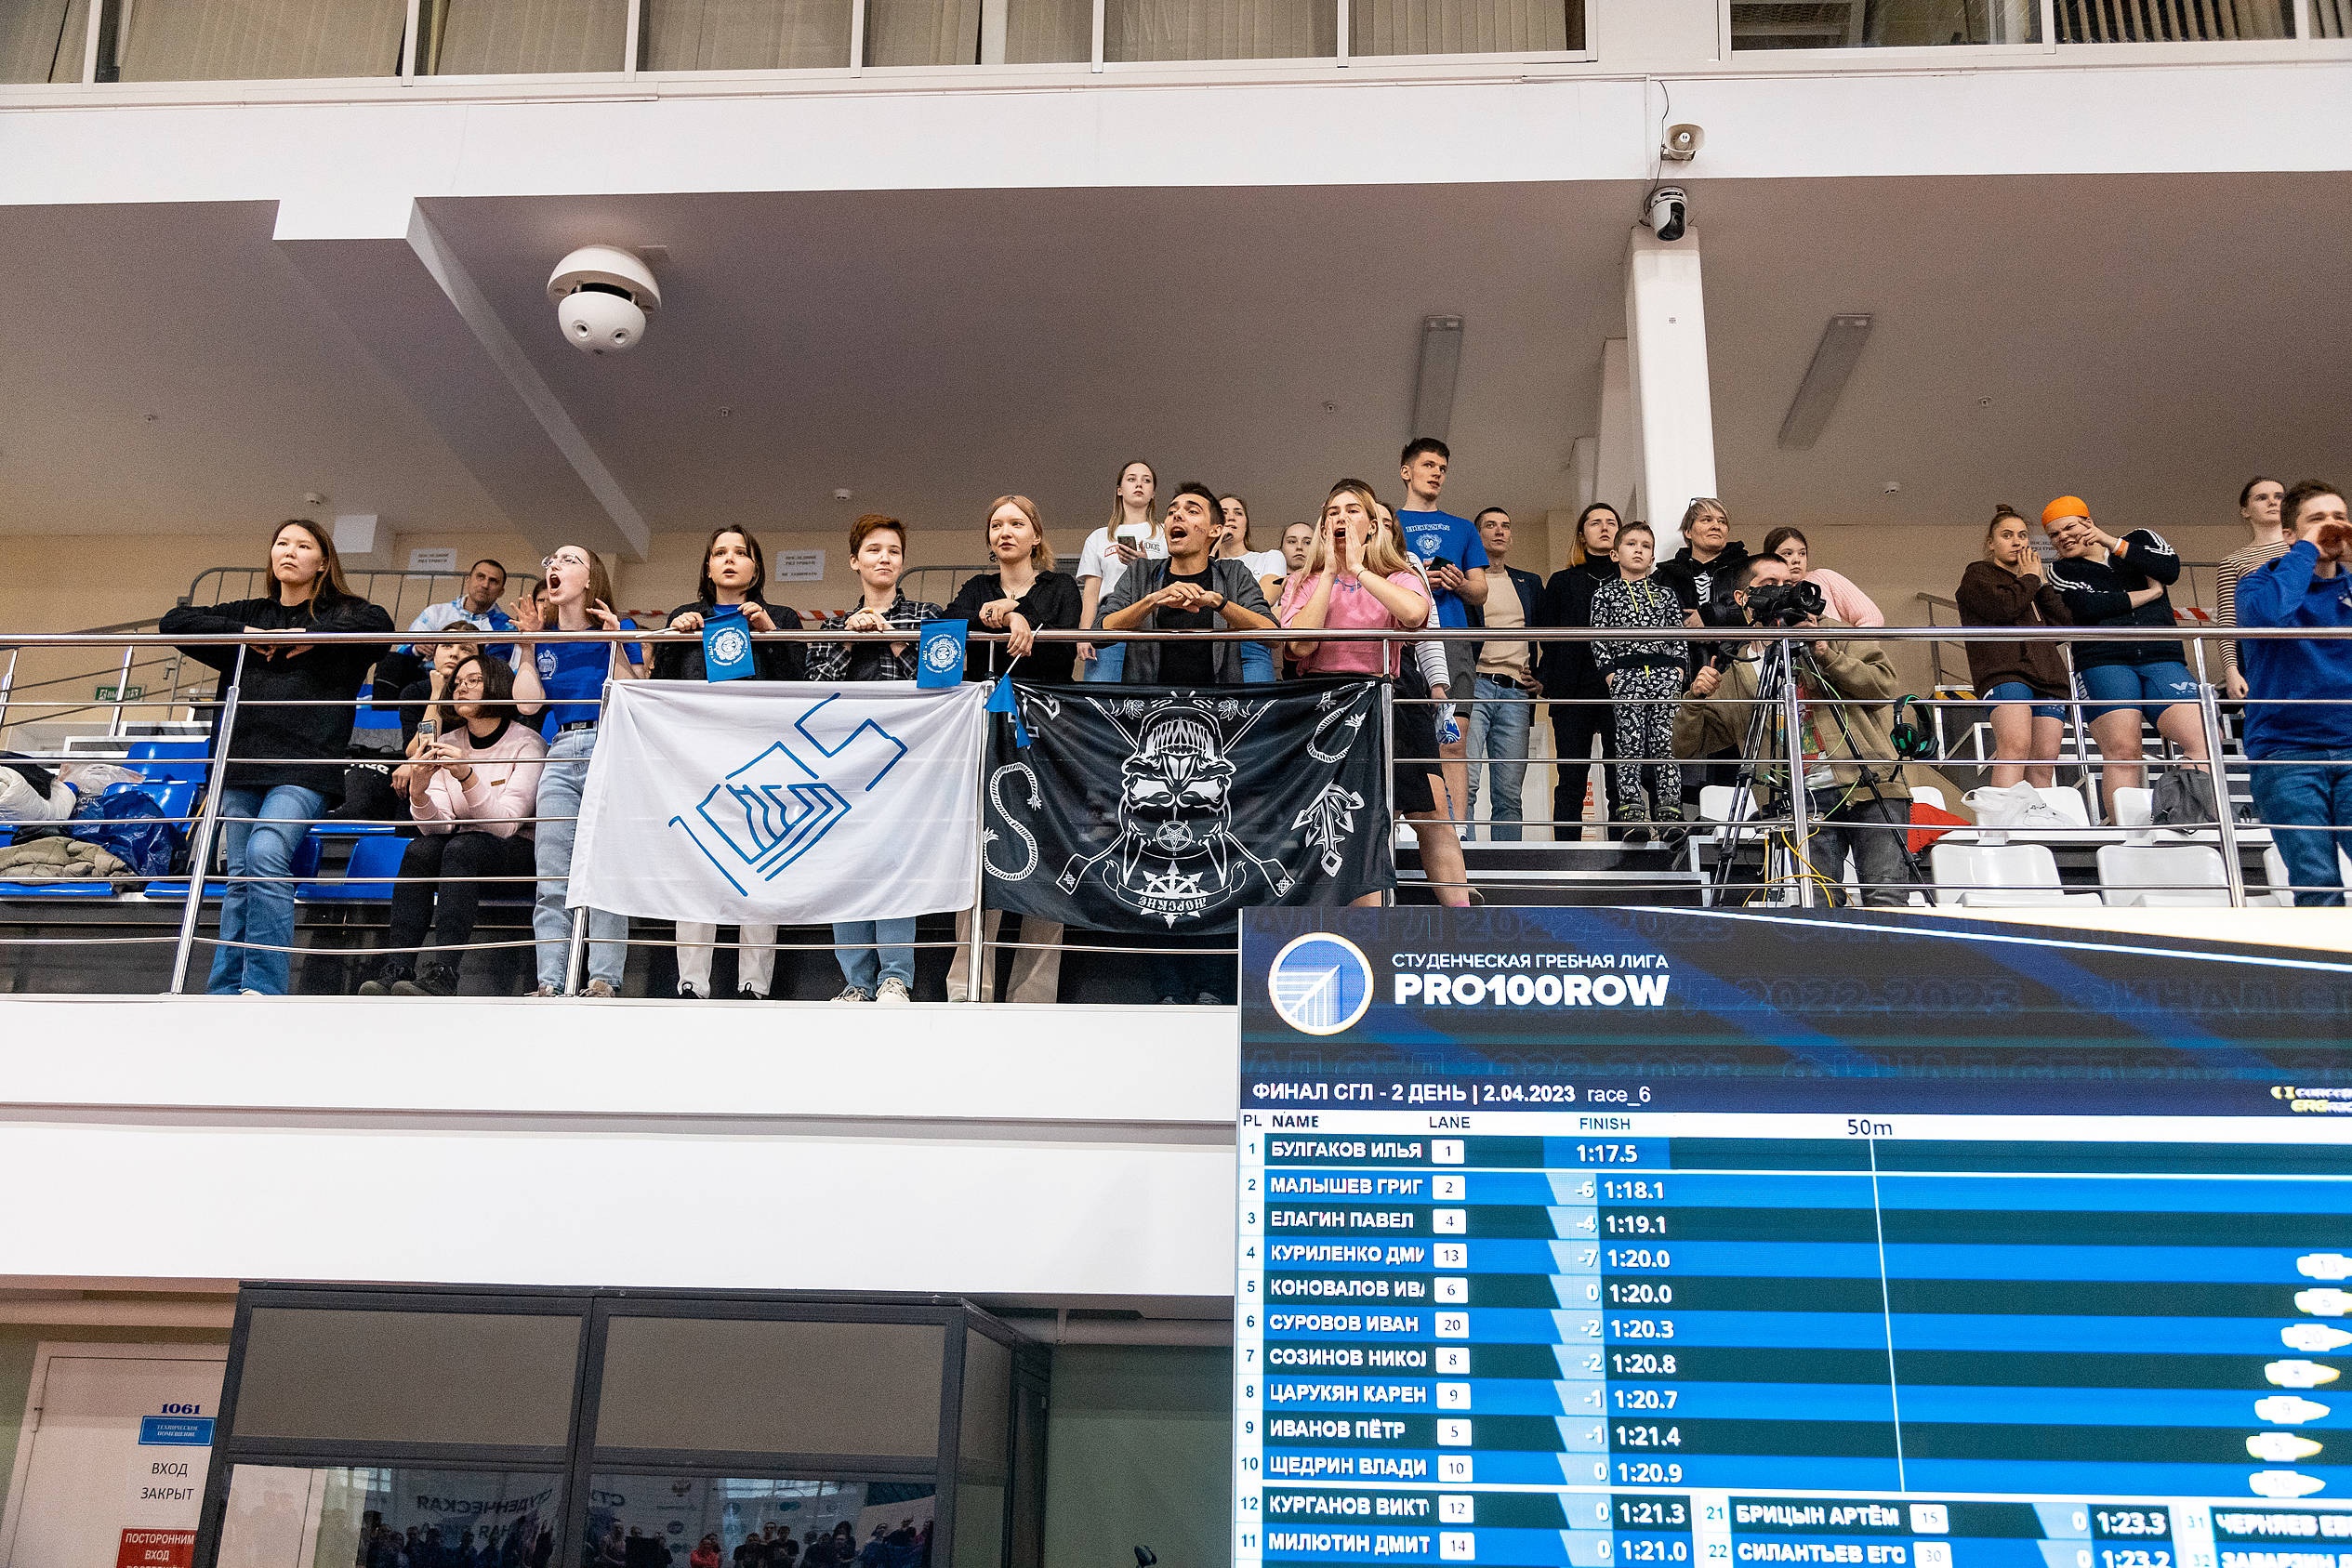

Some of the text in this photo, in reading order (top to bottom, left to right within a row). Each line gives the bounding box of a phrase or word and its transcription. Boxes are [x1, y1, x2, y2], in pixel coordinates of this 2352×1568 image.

[1137, 894, 1207, 912] МОРСКИЕ
[1391, 953, 1670, 970] СТУДЕНЧЕСКАЯ ГРЕБНАЯ ЛИГА
[1394, 973, 1671, 1007] PRO100ROW
[1252, 1082, 1328, 1100] ФИНАЛ
[1333, 1083, 1374, 1100] СГЛ
[1391, 1084, 1404, 1101] 2
[1407, 1084, 1467, 1104] ДЕНЬ
[1483, 1084, 1577, 1102] 2.04.2023
[1587, 1086, 1651, 1107] race_6
[1243, 1114, 1893, 1136] PL NAME LANE FINISH 50m
[1249, 1140, 1638, 1163] 1 БУЛГАКОВ ИЛЬЯ 1 1:17.5
[1248, 1178, 1256, 1191] 2
[1270, 1177, 1373, 1194] МАЛЫШЕВ
[1377, 1179, 1423, 1194] ГРИГ
[1445, 1181, 1453, 1193] 2
[1604, 1180, 1664, 1199] 1:18.1
[1248, 1211, 1256, 1225] 3
[1271, 1210, 1345, 1228] ЕЛАГИН
[1350, 1212, 1414, 1229] ПАВЕЛ
[1446, 1216, 1454, 1227] 4
[1605, 1215, 1666, 1233] 1:19.1
[1246, 1245, 1256, 1259] 4
[1271, 1245, 1382, 1262] КУРИЛЕНКО
[1443, 1249, 1459, 1262] 13
[1607, 1249, 1671, 1268] 1:20.0
[1247, 1280, 1255, 1293] 5
[1271, 1279, 1390, 1297] КОНОВАЛОВ
[1447, 1284, 1456, 1296] 6
[1609, 1284, 1672, 1303] 1:20.0
[1246, 1314, 1255, 1328] 6
[1269, 1314, 1362, 1331] СУРОВОВ
[1366, 1315, 1419, 1332] ИВАН
[1444, 1319, 1460, 1332] 20
[1611, 1319, 1674, 1338] 1:20.3
[1246, 1349, 1255, 1363] 7
[1269, 1348, 1364, 1366] СОЗИНОВ
[1448, 1353, 1457, 1365] 8
[1612, 1353, 1676, 1374] 1:20.8
[1246, 1385, 1254, 1399] 8
[1270, 1384, 1359, 1403] ЦАРУКЯН
[1363, 1385, 1426, 1403] КАРЕН
[1449, 1389, 1458, 1402] 9
[1615, 1390, 1678, 1409] 1:20.7
[161, 1403, 201, 1415] 1061
[1245, 1420, 1254, 1434] 9
[1270, 1419, 1351, 1438] ИВАНОВ
[1355, 1418, 1406, 1439] ПЁТР
[1451, 1426, 1459, 1438] 5
[1616, 1426, 1682, 1446] 1:21.4
[152, 1462, 189, 1478] ВХОД
[1241, 1456, 1259, 1471] 10
[1270, 1456, 1354, 1477] ЩЕДРИН
[1359, 1457, 1427, 1479] ВЛАДИ
[1449, 1462, 1464, 1475] 10
[1618, 1462, 1683, 1483] 1:20.9
[140, 1487, 194, 1501] ЗАКРЫТ
[1240, 1496, 1259, 1510] 12
[1269, 1496, 1371, 1515] КУРГАНОВ
[1376, 1497, 1430, 1516] ВИКТ
[1451, 1502, 1465, 1514] 12
[1620, 1502, 1685, 1524] 1:21.3
[1706, 1507, 1724, 1519] 21
[1736, 1505, 1826, 1527] БРИЦЫН
[1829, 1504, 1900, 1526] АРТЁМ
[1923, 1512, 1937, 1523] 15
[2096, 1512, 2166, 1535] 1:23.3
[126, 1533, 195, 1545] ПОСТОРОННИМ
[1241, 1534, 1256, 1548] 11
[1268, 1533, 1370, 1552] МИЛЮТИН
[1374, 1535, 1431, 1556] ДМИТ
[1452, 1539, 1466, 1552] 14
[1622, 1540, 1687, 1561] 1:21.0
[1709, 1545, 1726, 1557] 22
[1738, 1542, 1864, 1563] СИЛАНТЬЕВ
[2101, 1549, 2171, 1568] 1:23.2
[144, 1549, 170, 1562] ВХОД
